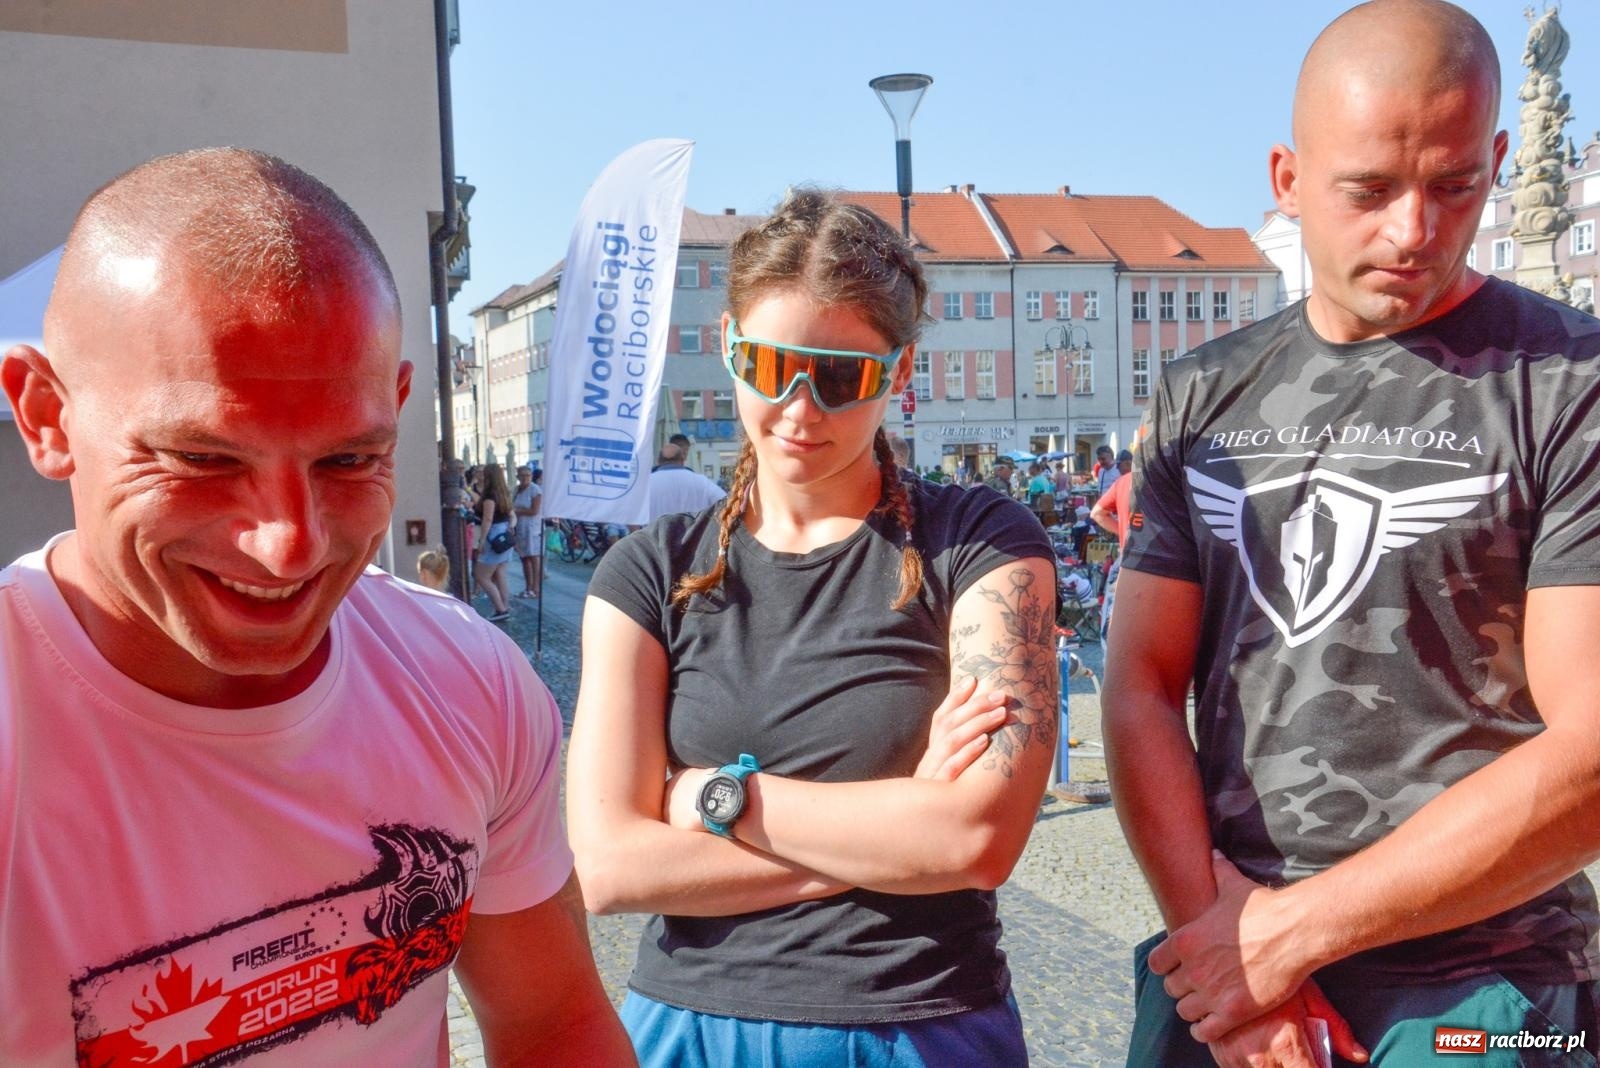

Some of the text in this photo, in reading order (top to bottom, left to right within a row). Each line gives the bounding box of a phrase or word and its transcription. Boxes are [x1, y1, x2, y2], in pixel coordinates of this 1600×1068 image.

[582, 221, 630, 418] Wodociągi
[618, 224, 658, 420] Raciborskie
[1209, 423, 1484, 455] BIEG GLADIATORA
[232, 928, 315, 972] FIREFIT
[251, 941, 316, 970] CHAMPIONSHIPS
[294, 946, 324, 961] EUROPE
[241, 957, 336, 1007] TORUŃ
[238, 978, 339, 1036] 2022
